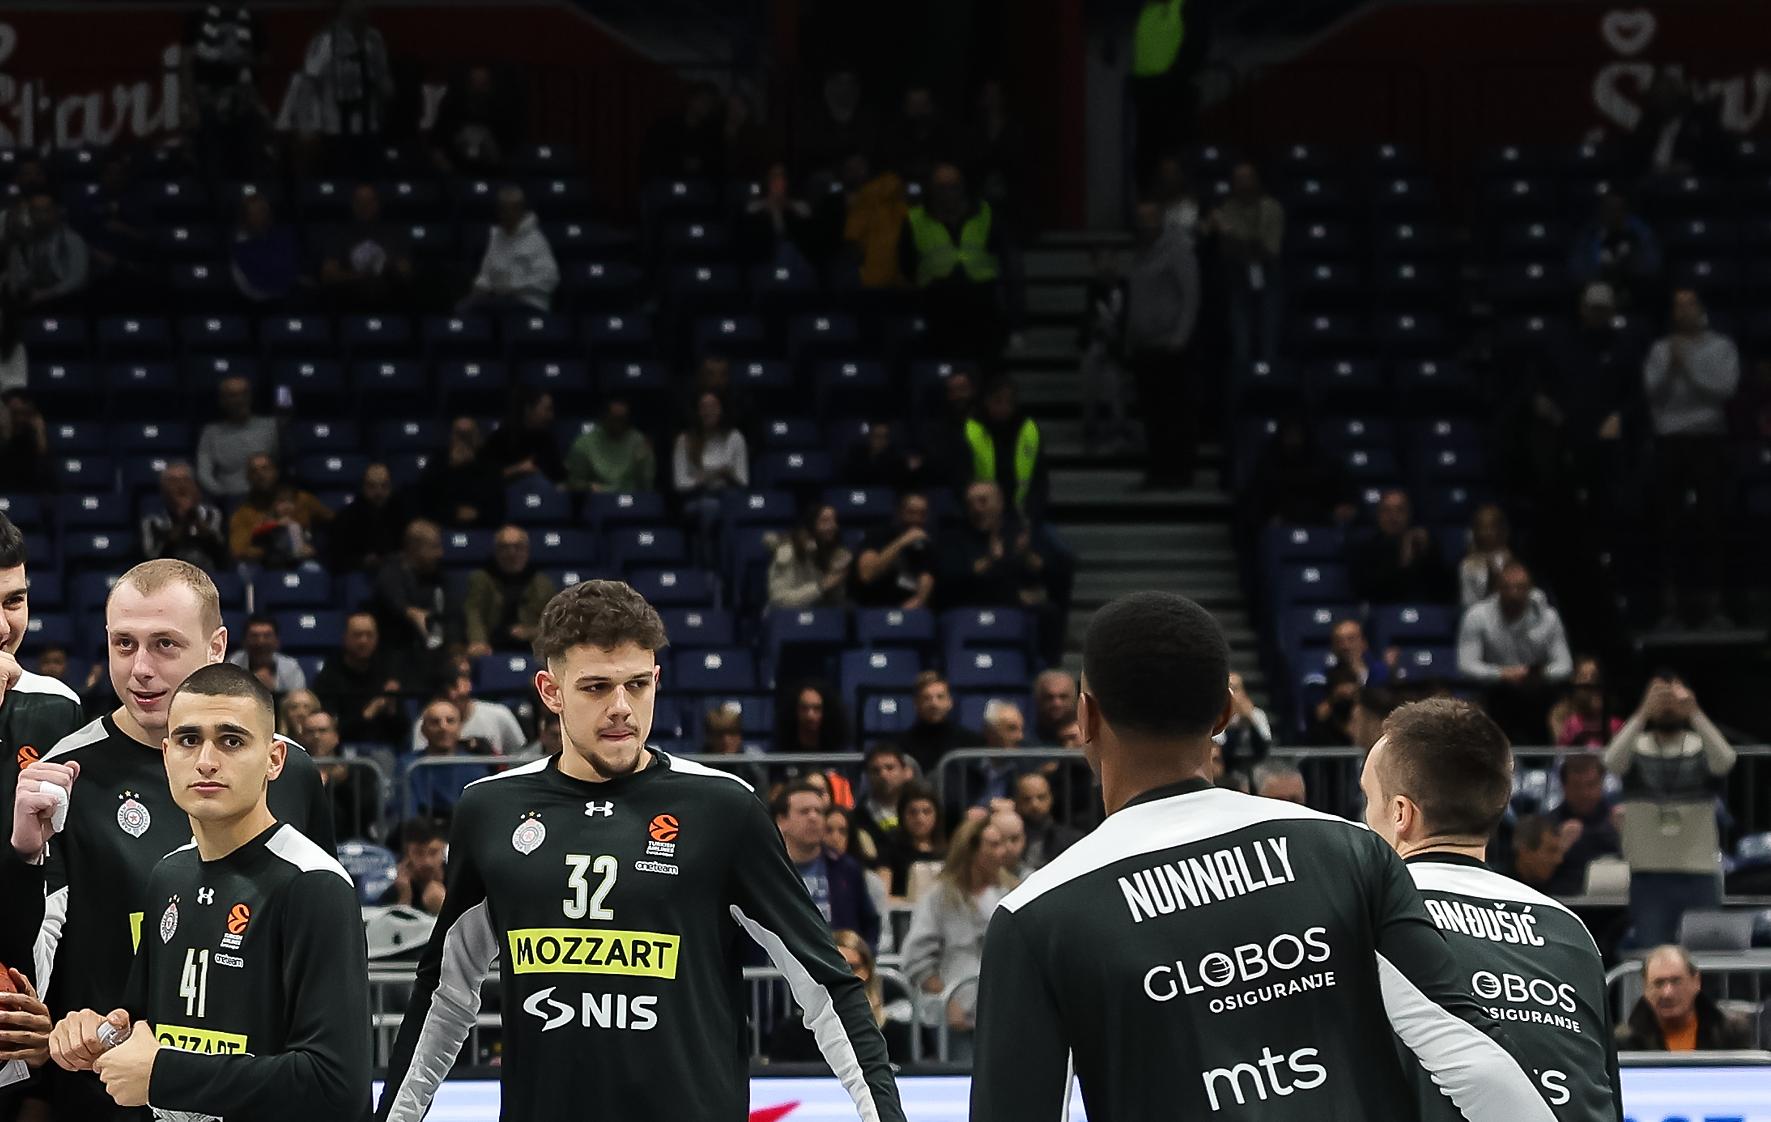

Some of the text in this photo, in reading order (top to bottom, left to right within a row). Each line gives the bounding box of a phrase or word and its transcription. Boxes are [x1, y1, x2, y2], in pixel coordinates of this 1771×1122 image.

[562, 854, 618, 920] 32
[1118, 836, 1296, 923] NUNNALLY
[179, 948, 209, 1018] 41
[517, 936, 673, 970] MOZZART
[1143, 927, 1331, 1001] GLOBOS
[582, 992, 658, 1031] NIS
[1209, 971, 1336, 1014] OSIGURANJE
[1471, 971, 1577, 1013] OBOS
[1202, 1046, 1327, 1111] mts
